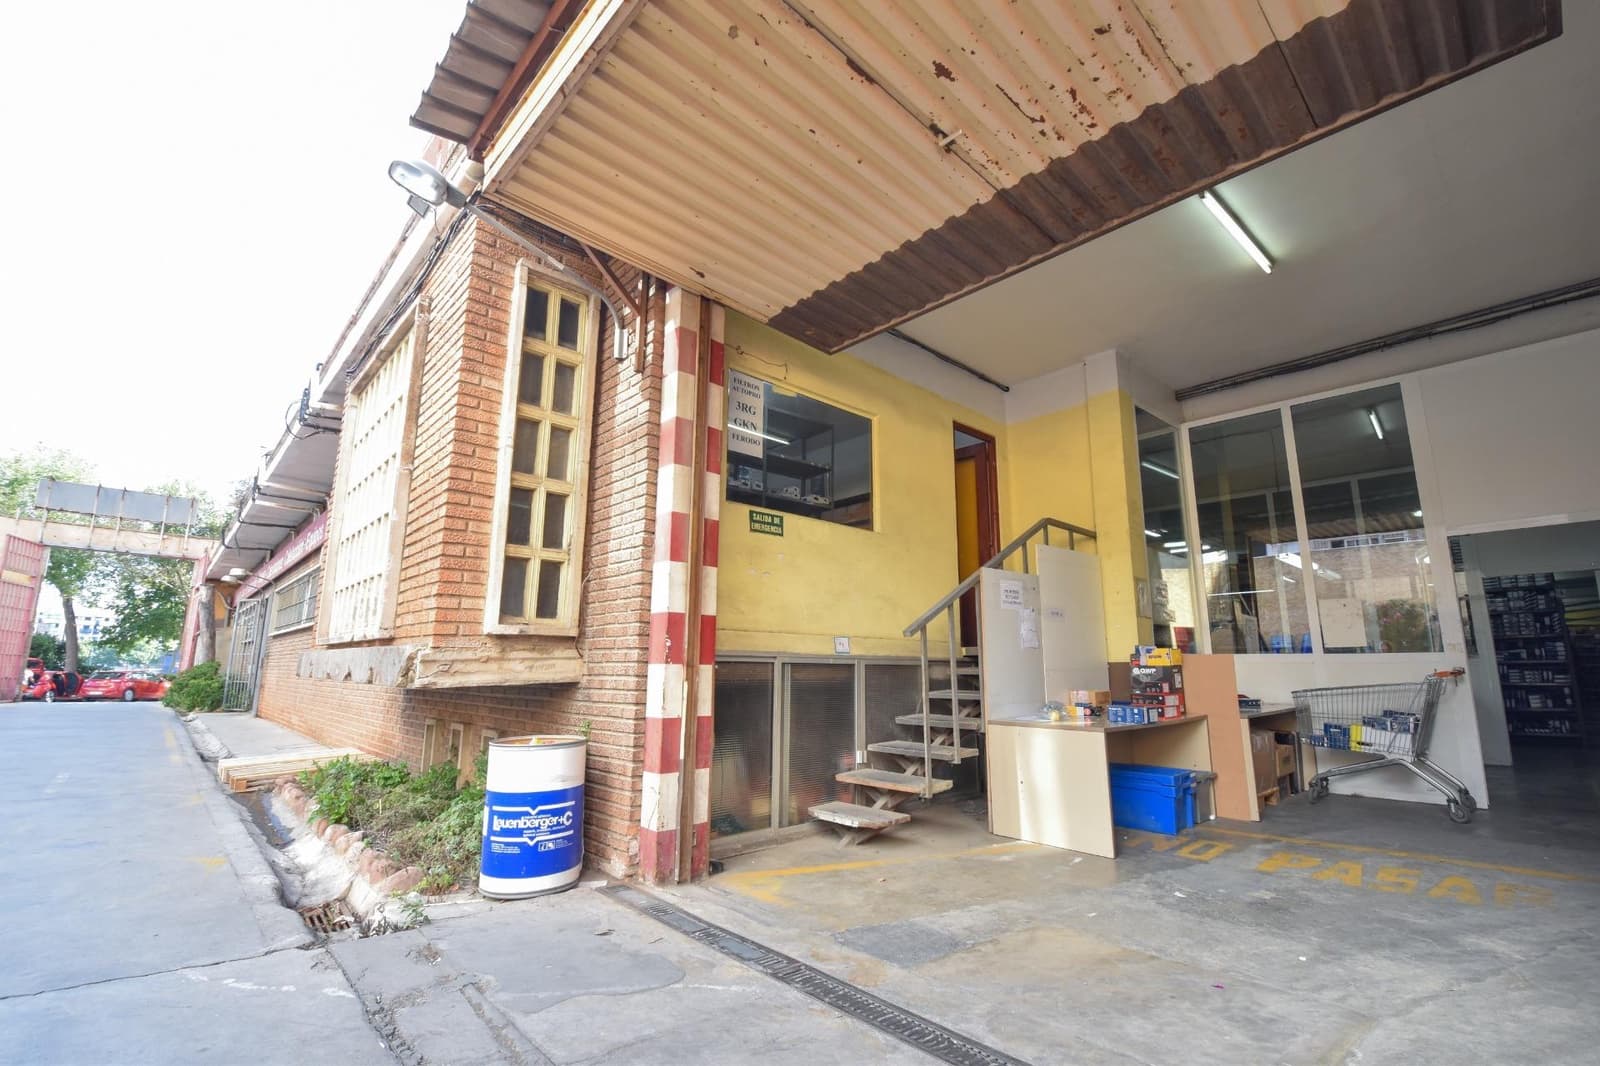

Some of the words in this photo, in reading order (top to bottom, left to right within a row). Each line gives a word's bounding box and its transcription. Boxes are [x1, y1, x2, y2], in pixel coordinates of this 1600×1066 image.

[733, 377, 760, 391] FILTROS
[732, 385, 761, 399] AUTOPRO
[735, 401, 756, 416] 3RG
[734, 417, 758, 431] GKN
[731, 433, 761, 446] FERODO
[752, 512, 772, 523] SALIDA
[773, 516, 781, 525] DE
[751, 522, 782, 534] EMERGENCIA
[1254, 851, 1558, 909] PASAR
